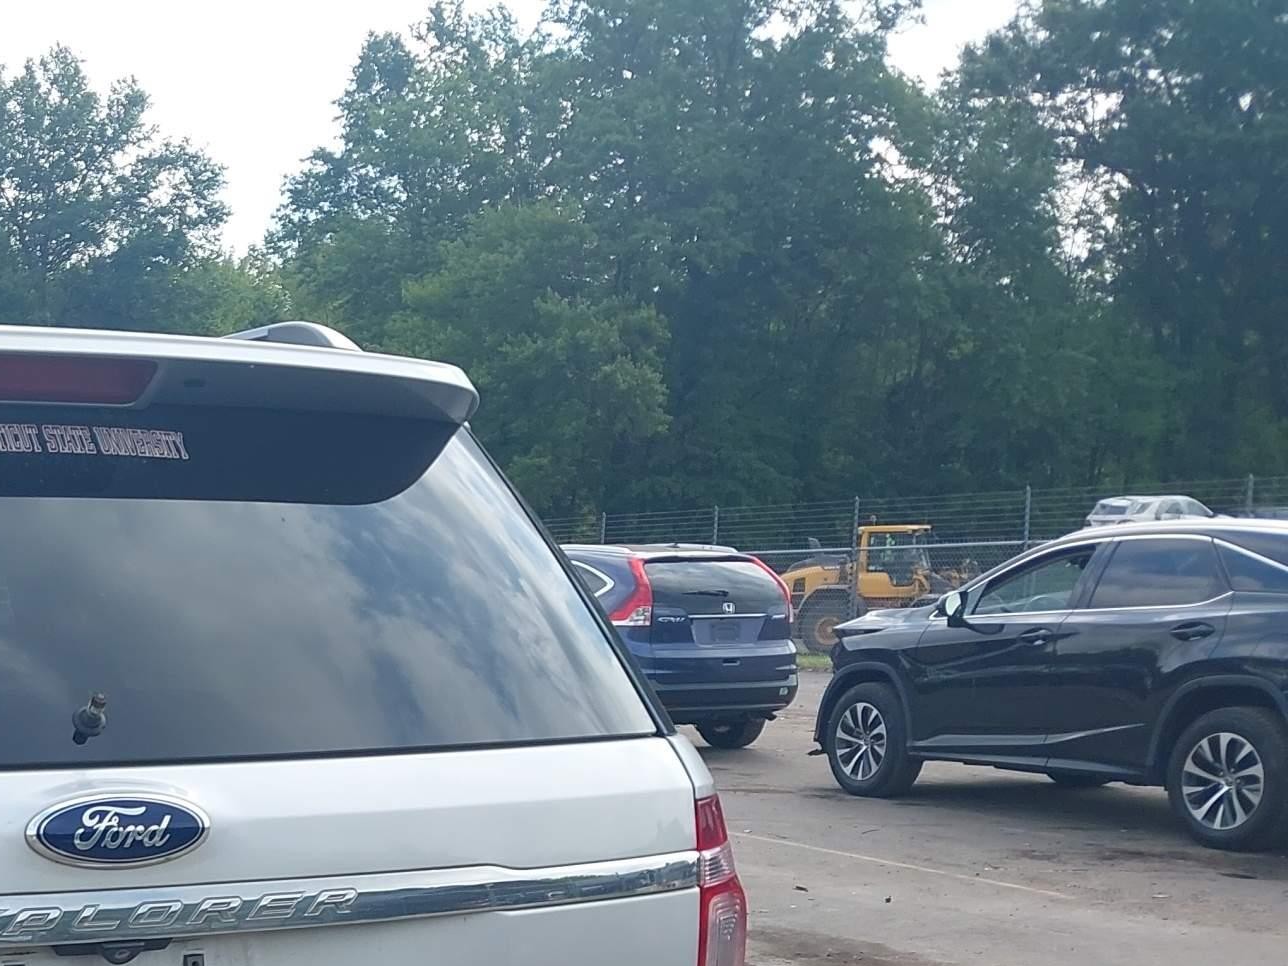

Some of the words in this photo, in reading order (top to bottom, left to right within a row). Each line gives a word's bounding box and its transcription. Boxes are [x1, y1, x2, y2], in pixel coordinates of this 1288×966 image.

[42, 424, 97, 454] STATE
[93, 426, 190, 460] UNIVERSITY
[73, 805, 173, 851] Ford
